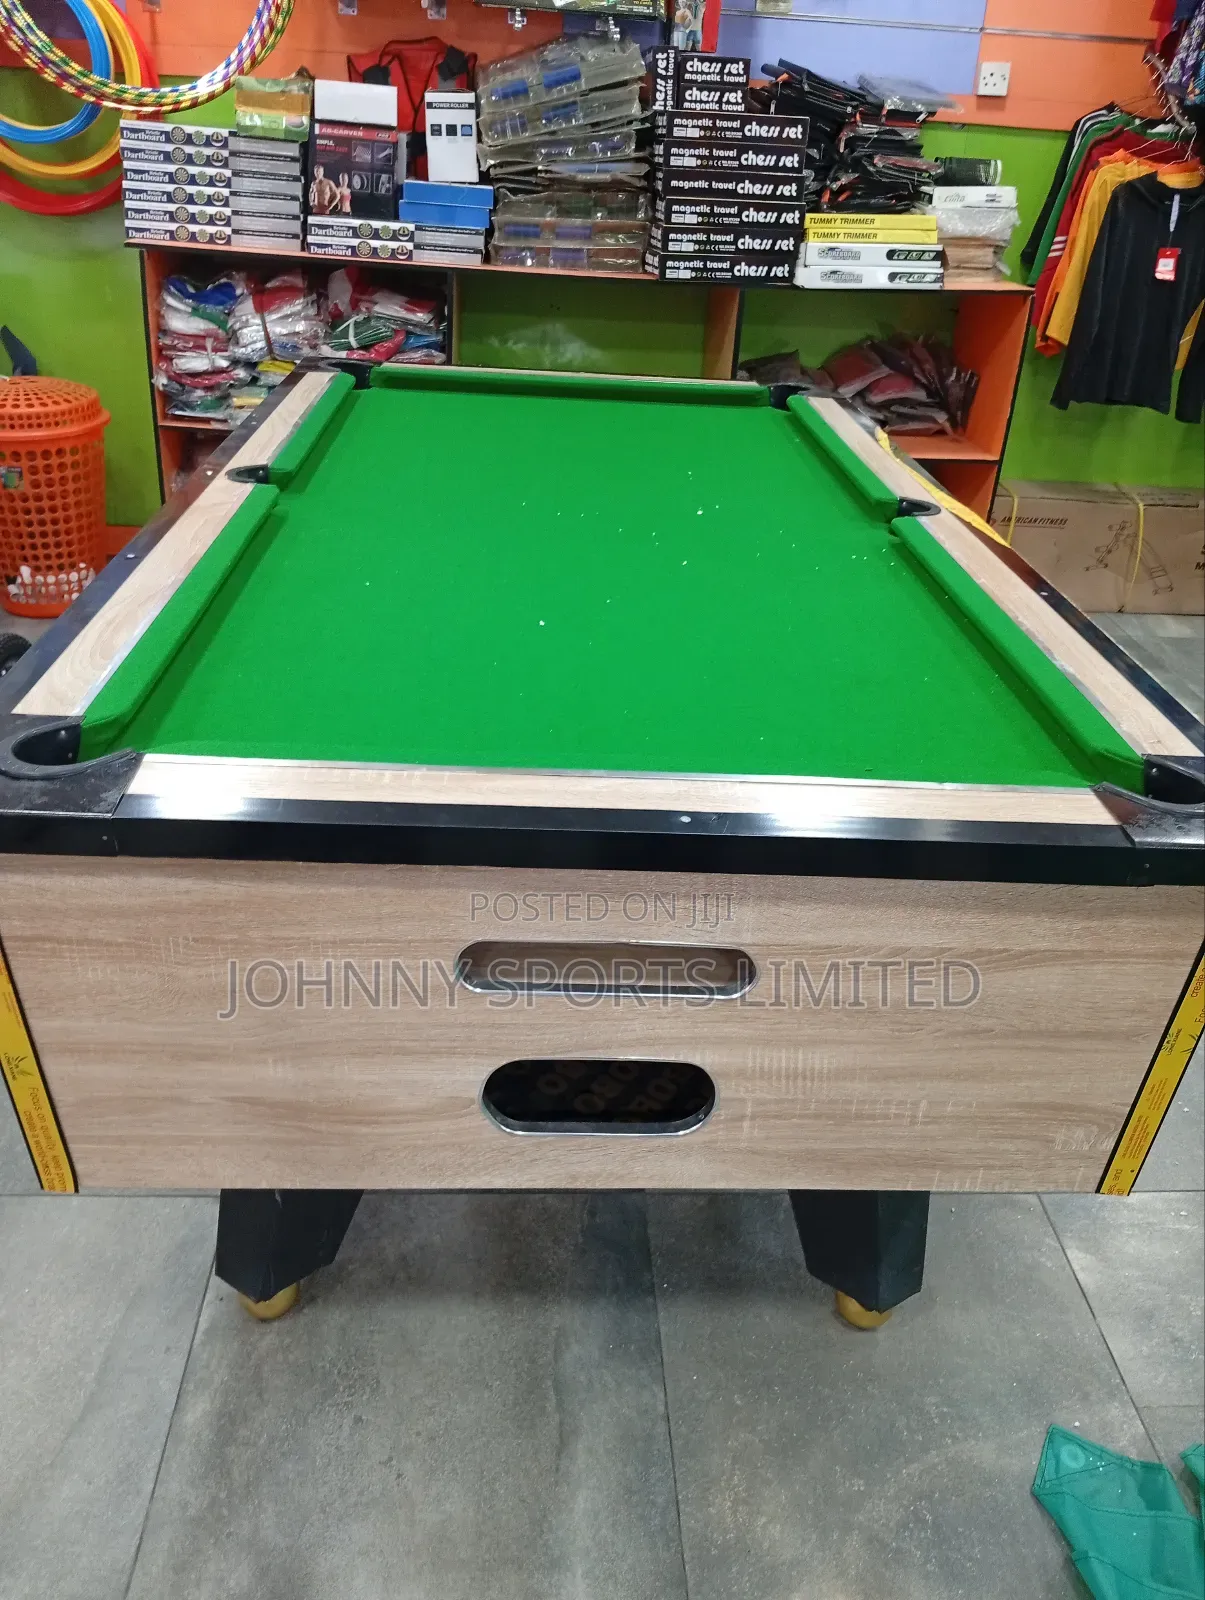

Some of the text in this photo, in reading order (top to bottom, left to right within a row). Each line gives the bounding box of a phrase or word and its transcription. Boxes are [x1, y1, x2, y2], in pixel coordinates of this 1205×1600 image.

[656, 53, 667, 75] set
[686, 58, 744, 74] chess set
[684, 73, 746, 83] magnetic travel
[652, 78, 666, 110] hess
[685, 87, 742, 103] chess set
[683, 102, 744, 111] magnetic travel
[674, 118, 740, 128] magnetic travel
[744, 121, 780, 138] chess
[782, 125, 803, 139] set
[123, 130, 165, 142] Dartboard
[124, 150, 164, 161] Dartboard
[670, 148, 737, 157] magnetic travel
[741, 151, 776, 166] chess
[779, 154, 799, 168] set
[127, 171, 169, 183] Dartboard
[670, 180, 736, 190] magnetic travel
[737, 180, 797, 196] chess set
[126, 191, 167, 202] Dartboard
[672, 204, 738, 214] magnetic travel
[128, 211, 169, 221] Dartboard
[742, 207, 778, 224] chess
[780, 210, 800, 225] set
[129, 230, 170, 240] Dartboard
[312, 227, 352, 237] Dartboard
[669, 232, 734, 242] magnetic travel
[737, 235, 773, 250] chess
[774, 237, 794, 251] set
[310, 246, 352, 256] Dartboard
[666, 260, 730, 269] magnetic travel
[734, 262, 767, 277] chess
[770, 264, 789, 278] set
[1038, 517, 1068, 525] FITNESS
